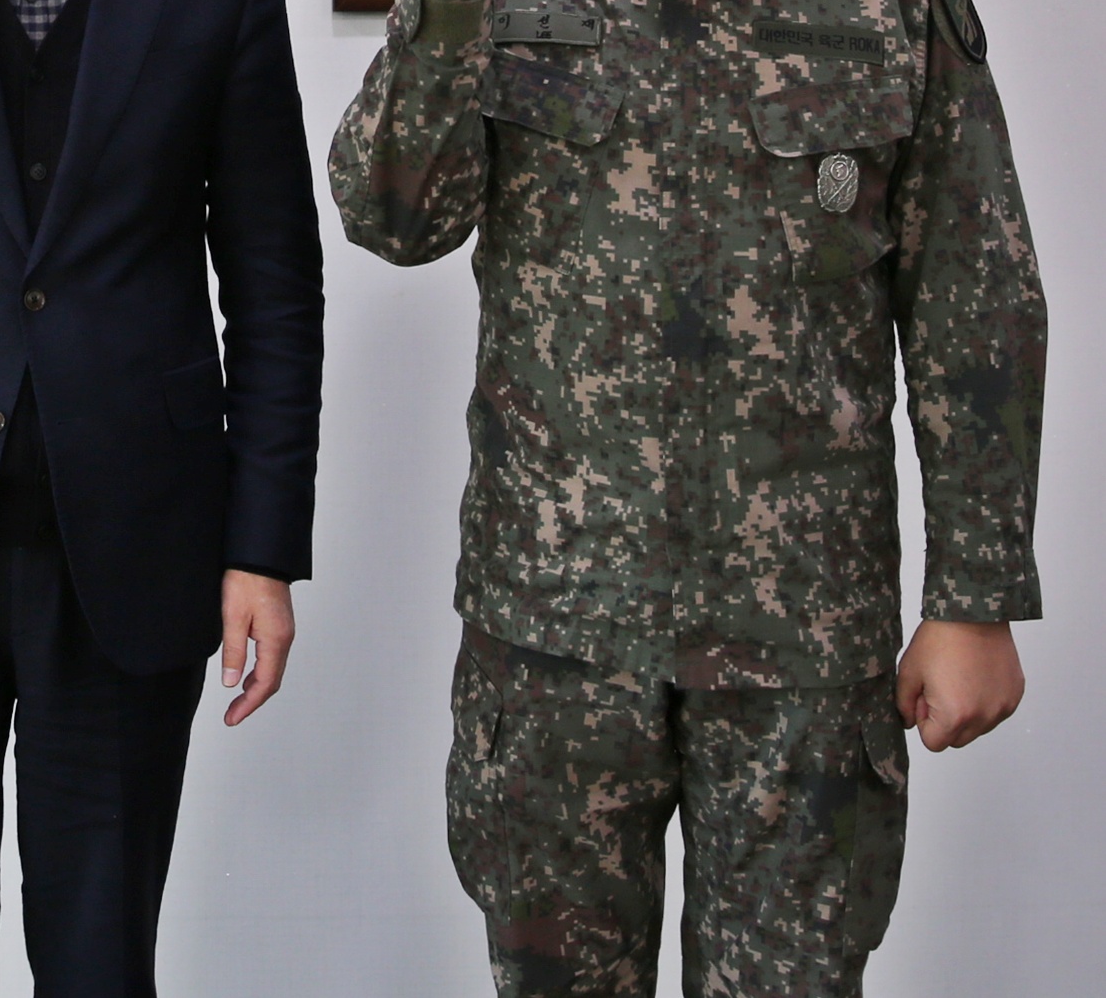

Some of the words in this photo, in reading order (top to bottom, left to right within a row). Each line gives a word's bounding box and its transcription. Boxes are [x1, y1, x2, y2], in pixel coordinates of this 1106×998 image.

[758, 28, 813, 47] 대한민국
[818, 33, 844, 50] 육군
[848, 36, 881, 54] ROKA
